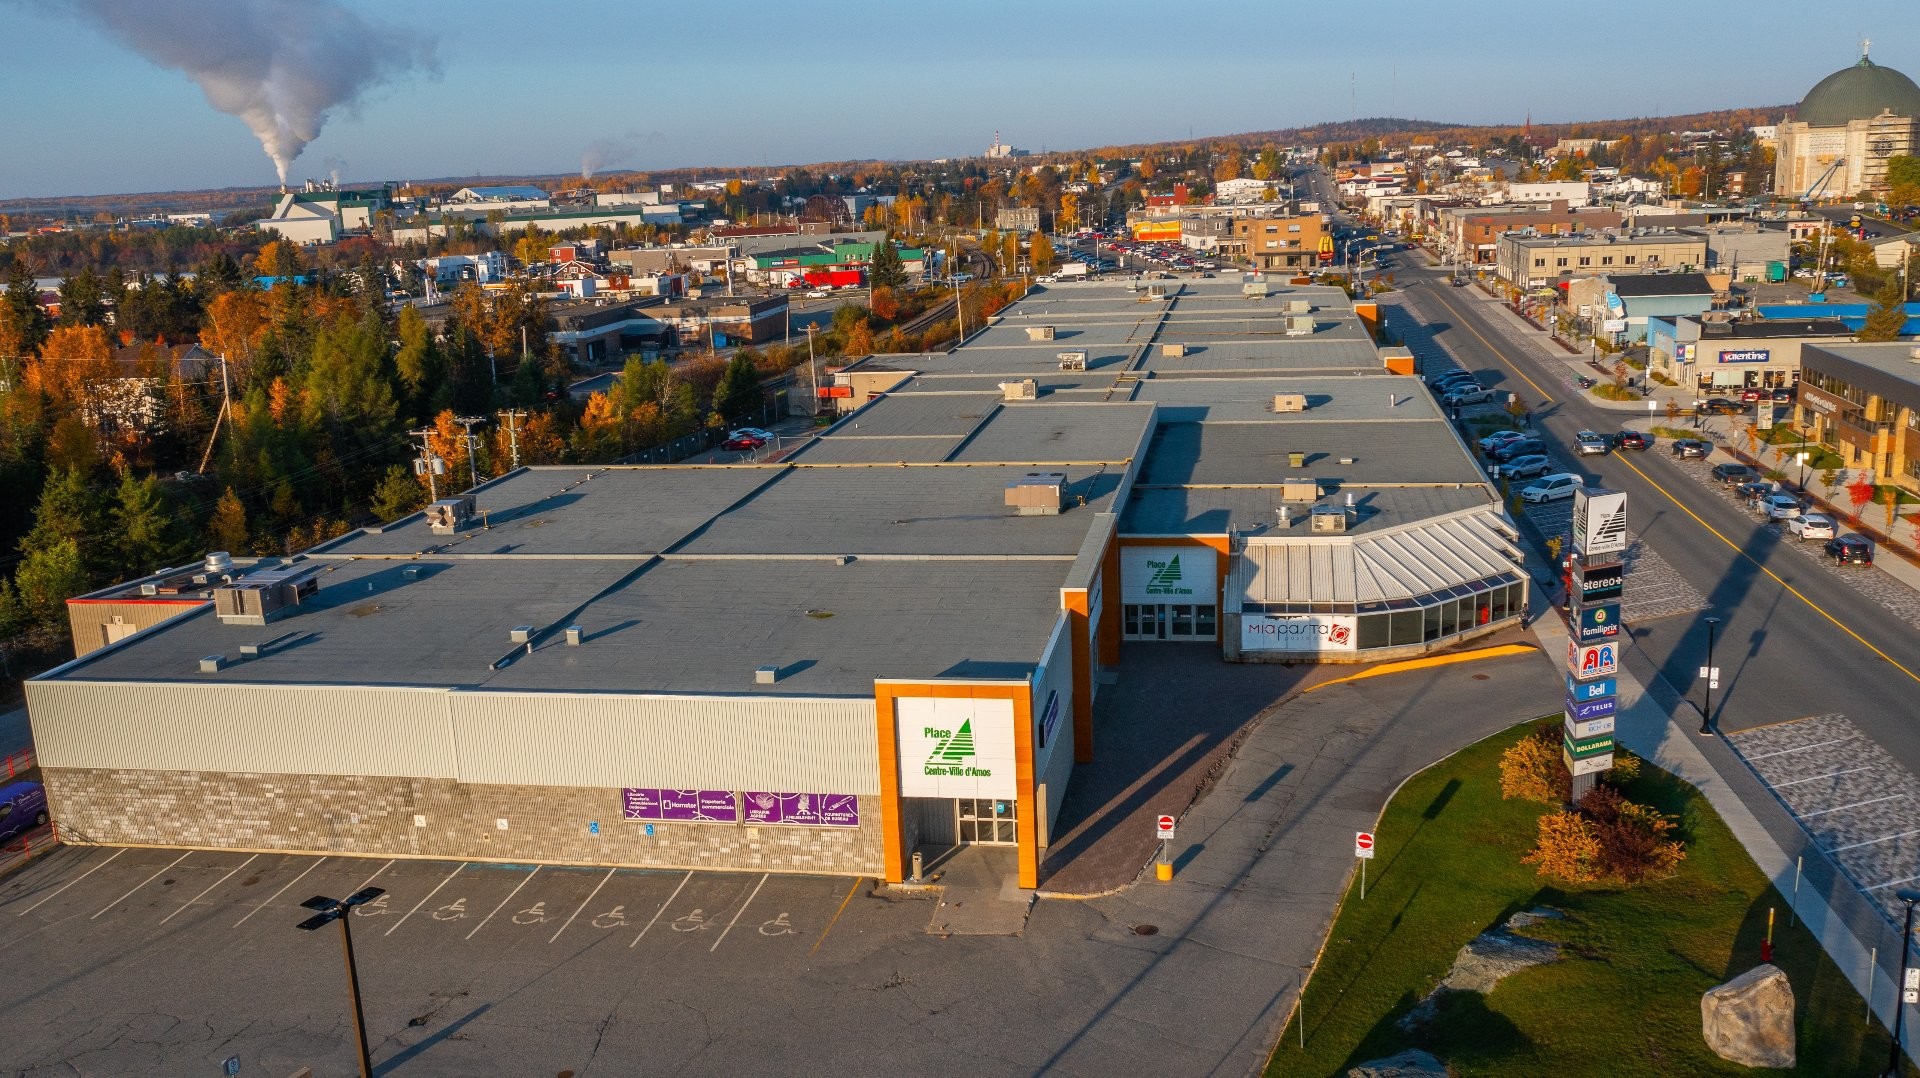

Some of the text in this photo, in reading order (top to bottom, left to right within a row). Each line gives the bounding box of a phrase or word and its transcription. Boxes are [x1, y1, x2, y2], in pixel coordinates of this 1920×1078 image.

[1147, 560, 1166, 569] Place
[1583, 576, 1623, 591] stereo+
[1582, 624, 1618, 636] familiprix
[1588, 683, 1605, 697] Bell
[1592, 702, 1613, 712] TELUS
[924, 727, 951, 739] Place
[1576, 740, 1612, 753] DOLLARAMA
[924, 766, 992, 777] Centre-Ville d'Amos
